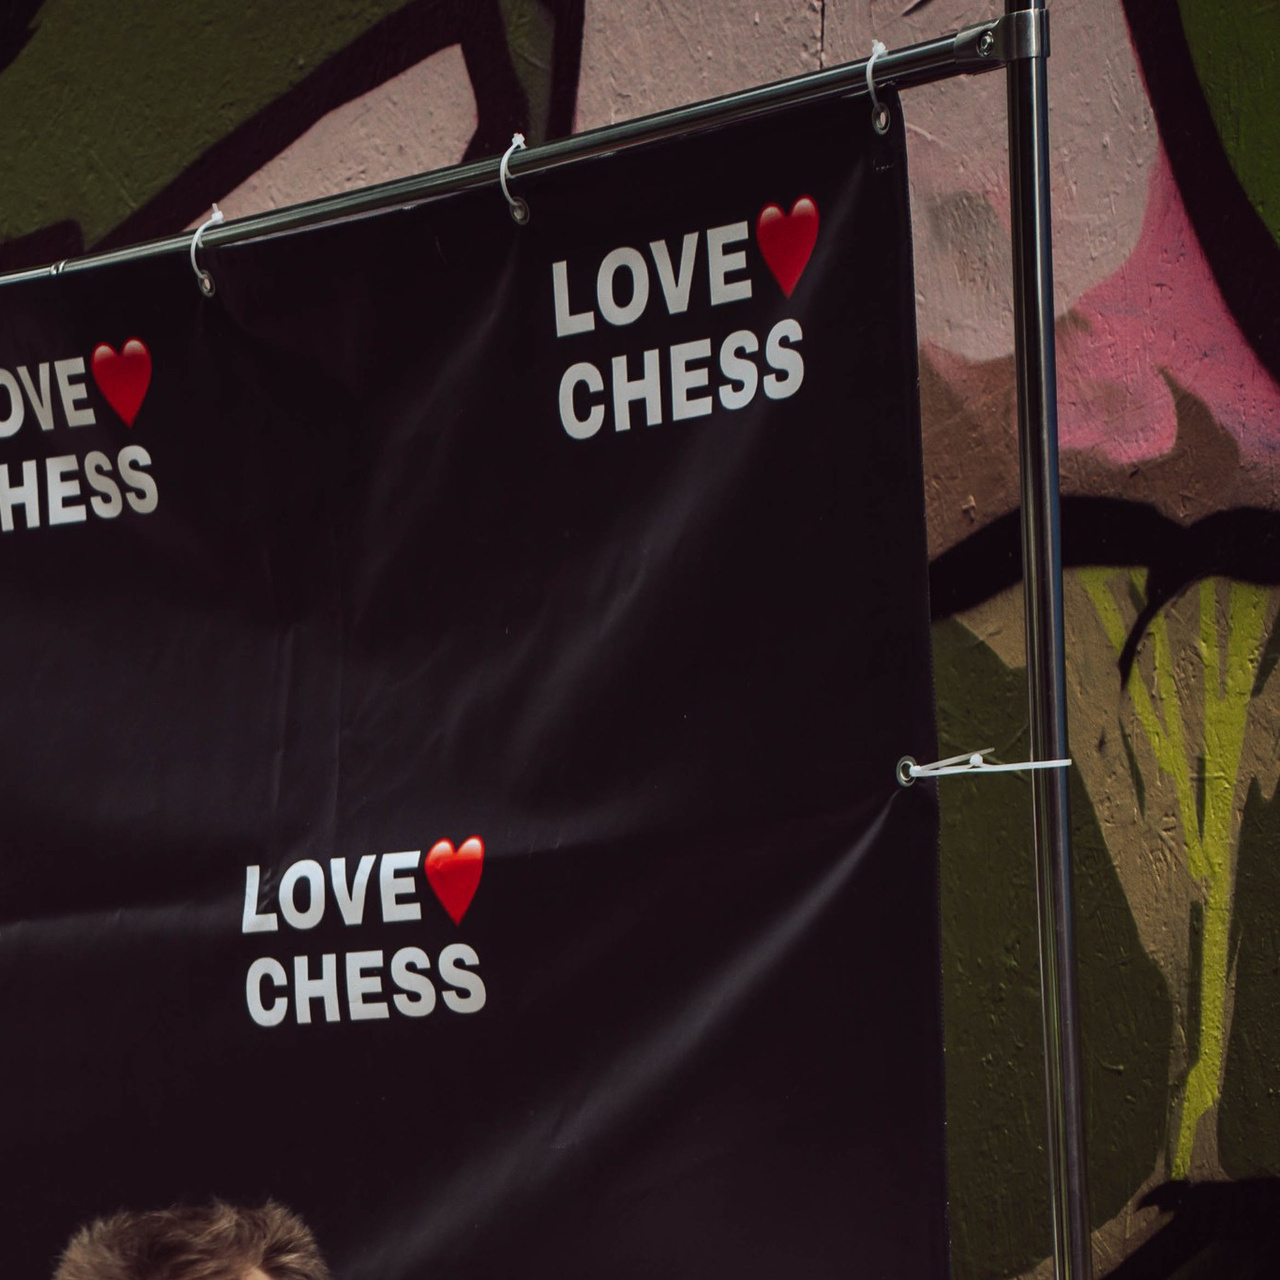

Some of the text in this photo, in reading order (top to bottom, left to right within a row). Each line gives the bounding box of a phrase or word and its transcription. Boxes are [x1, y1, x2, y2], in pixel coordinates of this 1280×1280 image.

[551, 219, 754, 339] LOVE
[557, 317, 806, 441] CHESS
[240, 849, 423, 935] LOVE
[244, 942, 488, 1028] CHESS
